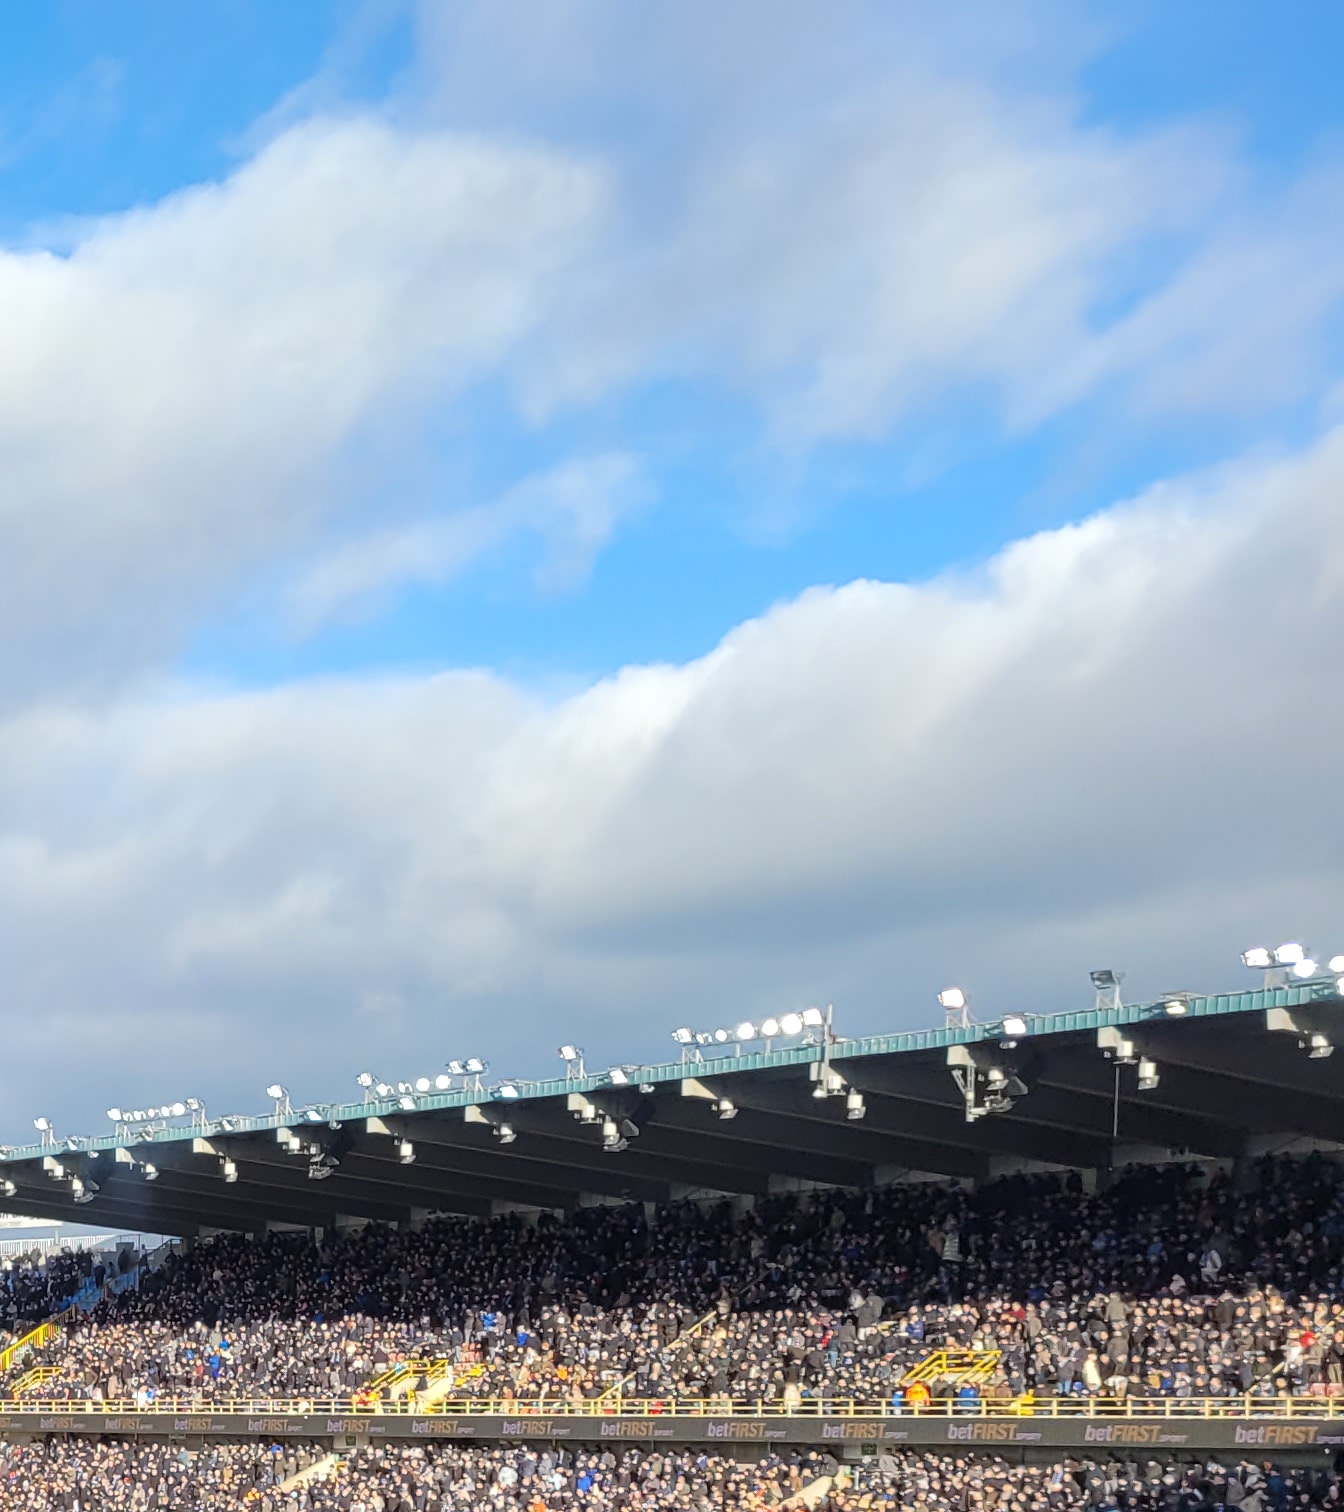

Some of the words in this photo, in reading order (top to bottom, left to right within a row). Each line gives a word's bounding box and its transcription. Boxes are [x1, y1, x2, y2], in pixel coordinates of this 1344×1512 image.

[327, 1419, 371, 1433] betFIRST
[412, 1419, 459, 1434] betFIRST
[502, 1420, 553, 1435] betFIRST
[600, 1421, 655, 1437] betFIRST
[707, 1421, 766, 1437] betFIRST
[822, 1422, 886, 1439] betFIRST
[947, 1423, 1018, 1440] betFIRST
[1084, 1424, 1162, 1442] betFIRST
[1235, 1425, 1319, 1444] betFIRST
